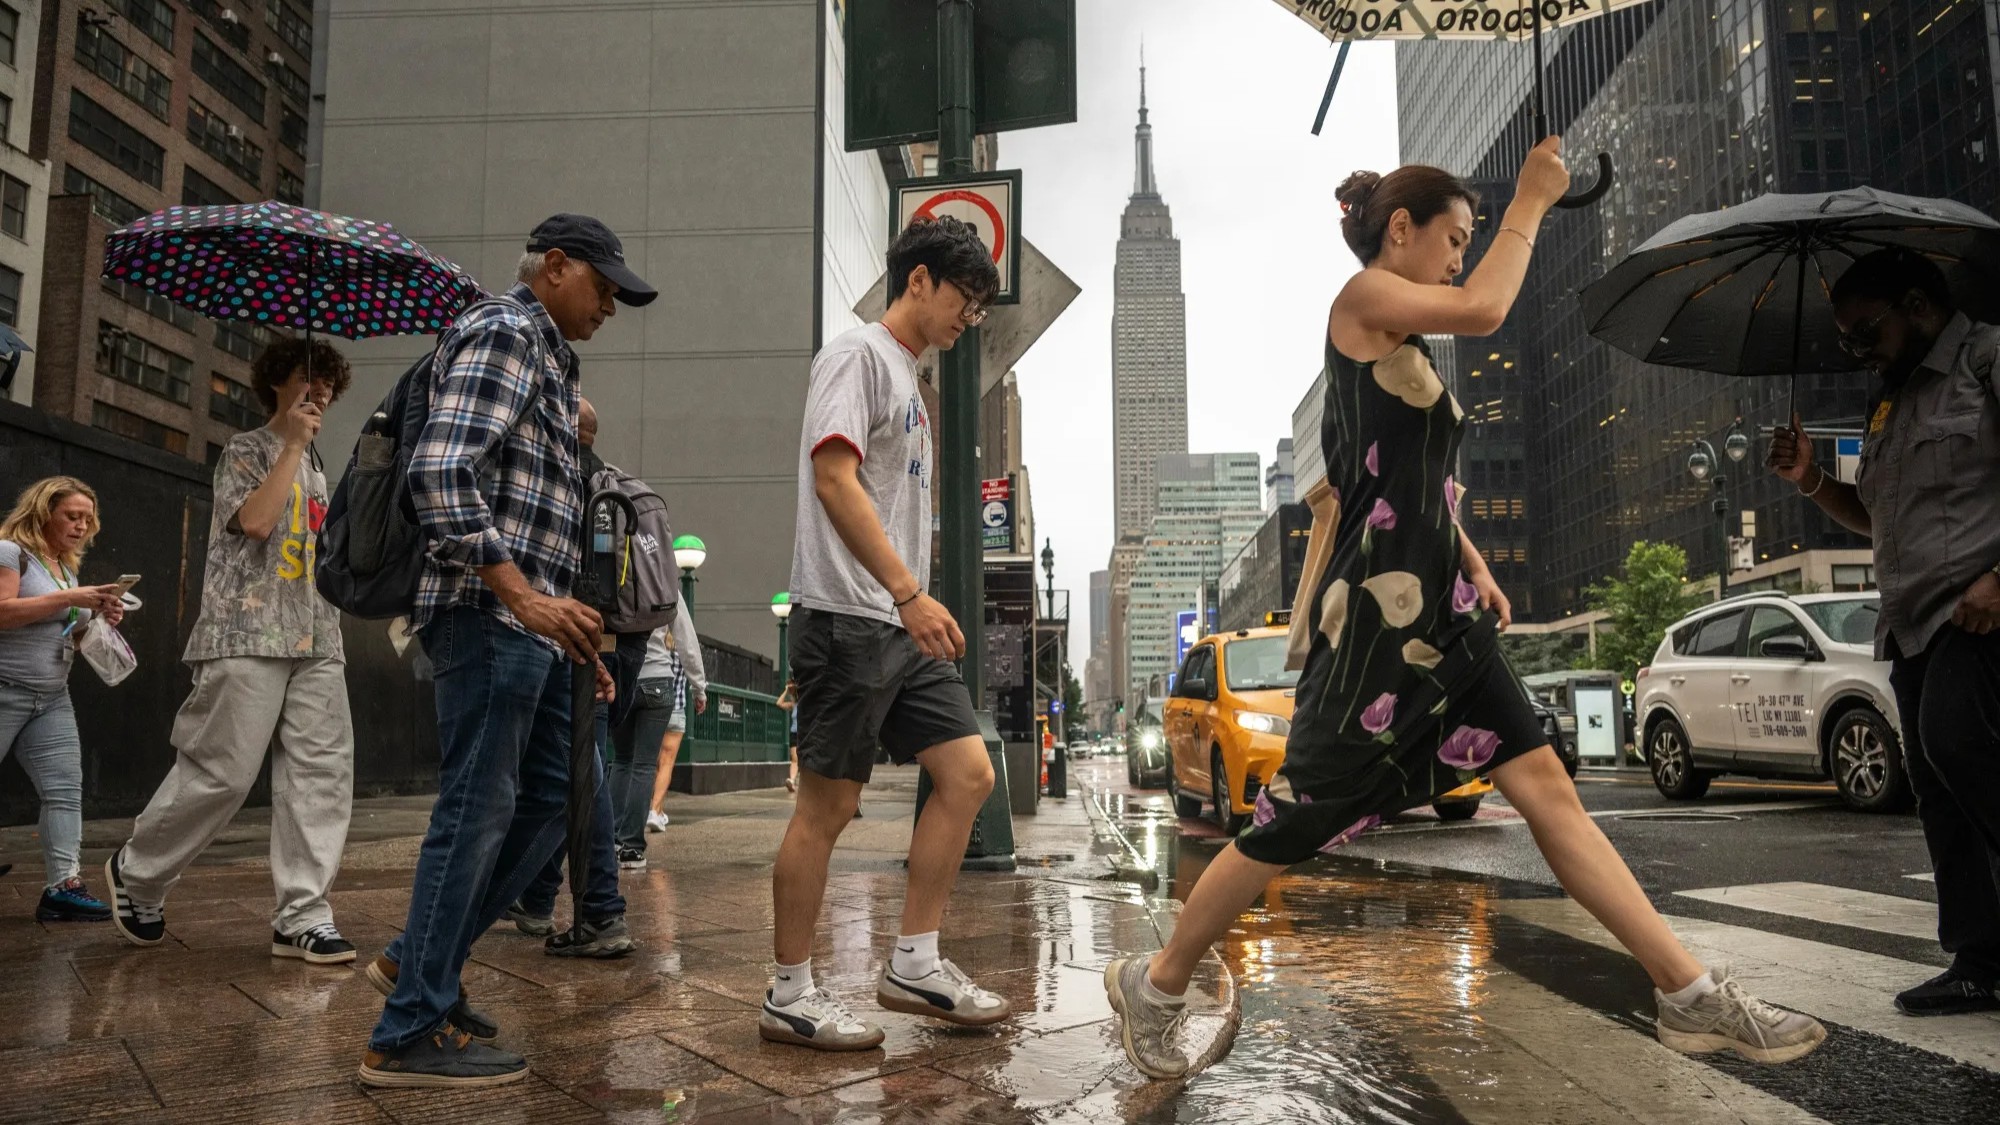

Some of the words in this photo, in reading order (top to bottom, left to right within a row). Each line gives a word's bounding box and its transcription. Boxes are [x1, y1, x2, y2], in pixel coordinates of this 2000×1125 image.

[982, 486, 1008, 495] STANDING
[1758, 694, 1777, 707] 30-30
[1793, 694, 1804, 707] AVE
[1736, 702, 1758, 723] TEI
[1763, 709, 1773, 721] LIC
[1774, 710, 1782, 721] NY
[1784, 710, 1802, 722] 11101
